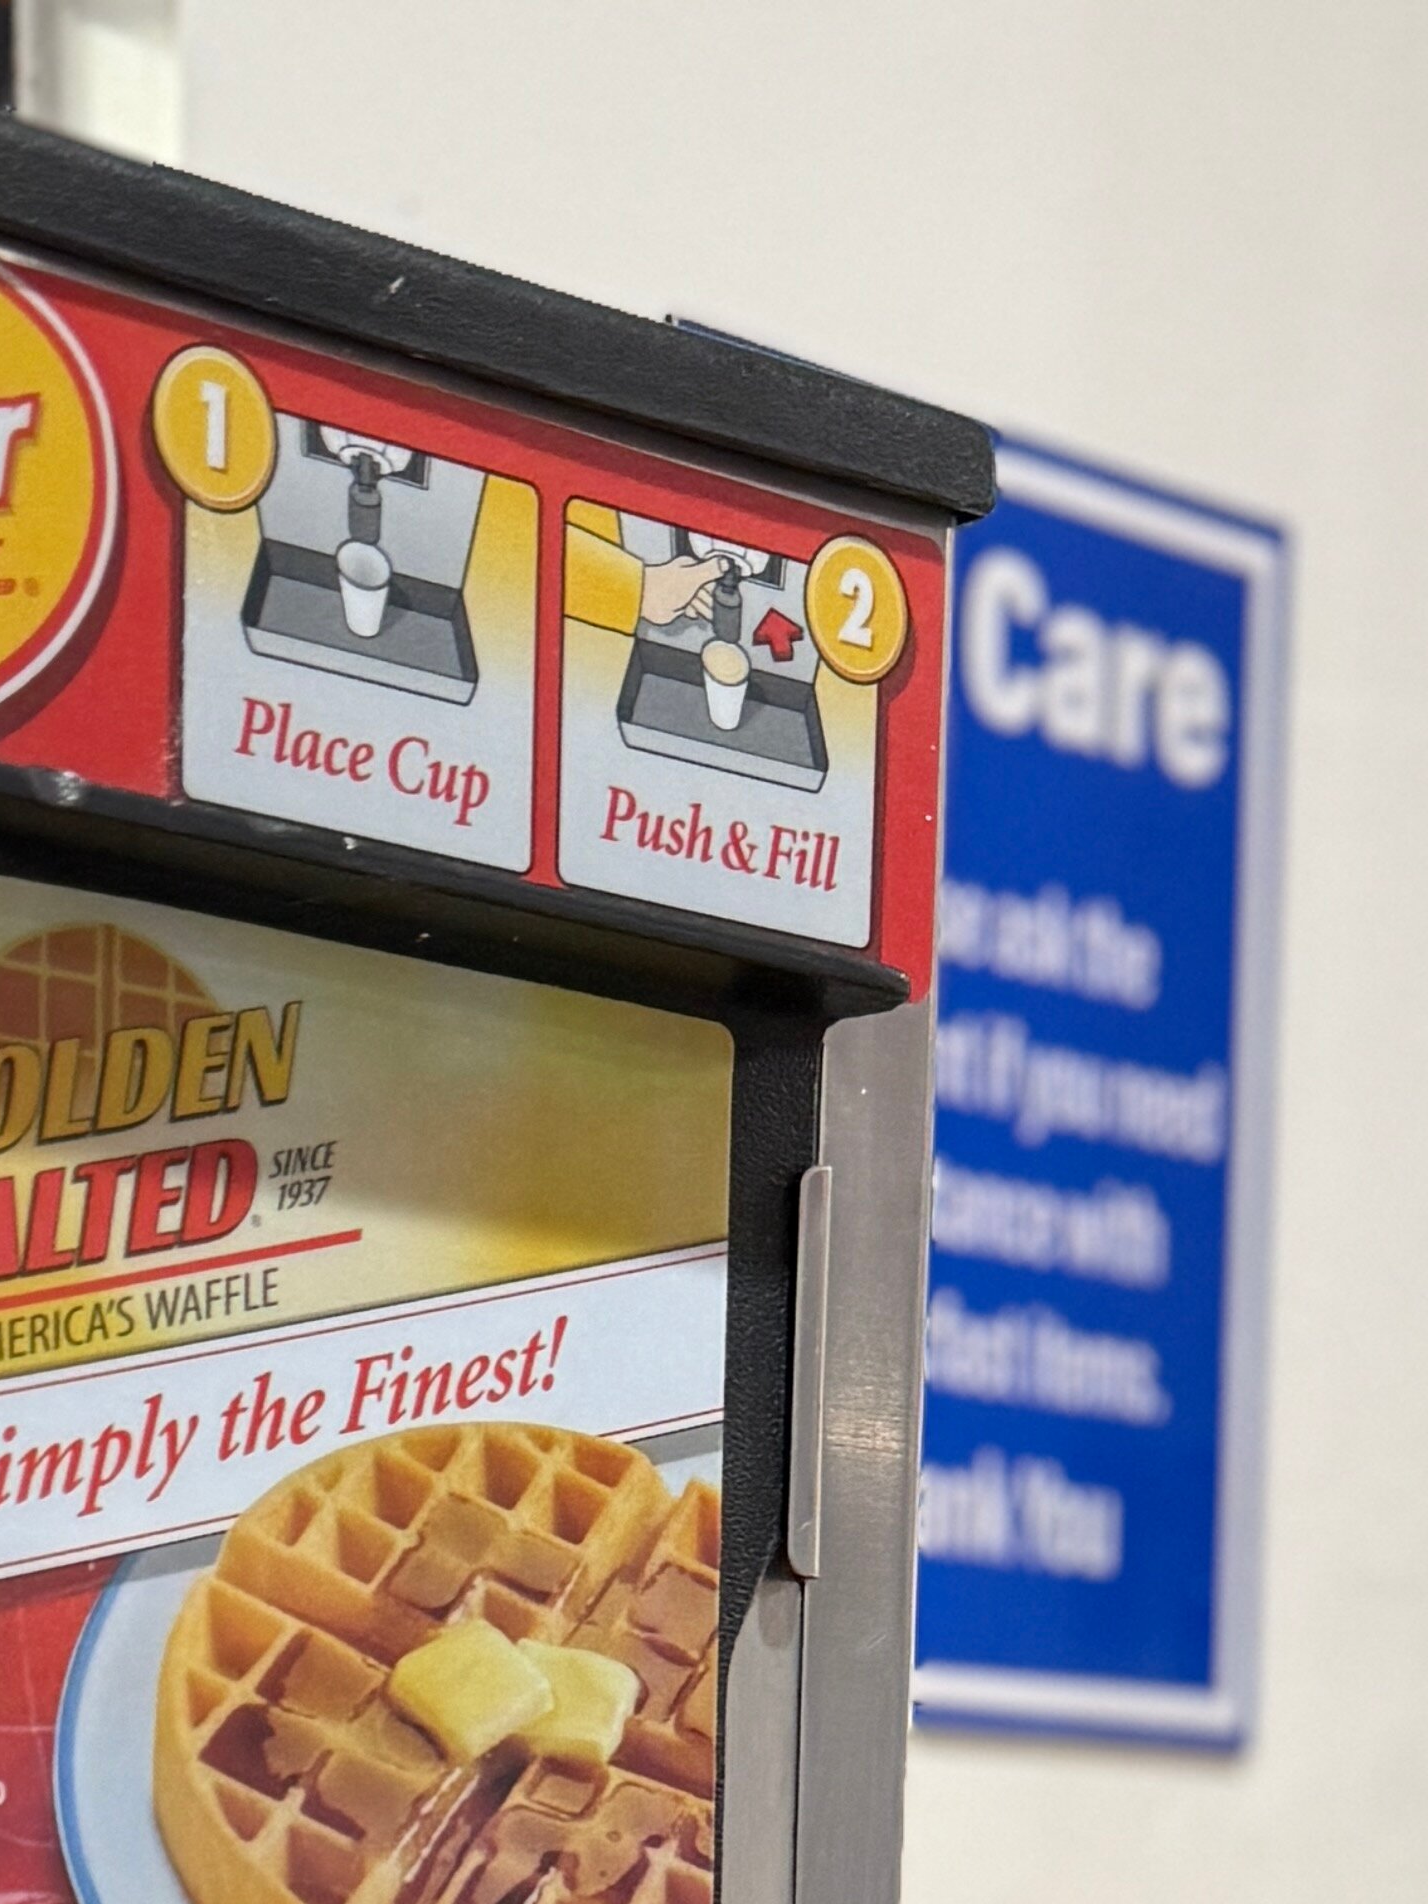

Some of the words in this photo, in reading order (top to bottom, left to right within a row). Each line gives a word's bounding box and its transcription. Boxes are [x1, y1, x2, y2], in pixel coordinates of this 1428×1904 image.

[201, 380, 228, 472] 1
[837, 568, 876, 649] 2
[961, 545, 1231, 792] Care
[234, 696, 374, 783] Place
[387, 735, 491, 827] Cup
[599, 786, 714, 865] Push
[720, 821, 759, 877] &
[762, 823, 842, 893] Fill
[269, 1141, 338, 1179] SINCE
[277, 1176, 331, 1211] 1937
[146, 1267, 280, 1331] WAFFLE
[218, 1371, 326, 1462] the
[338, 1314, 570, 1436] Finest!
